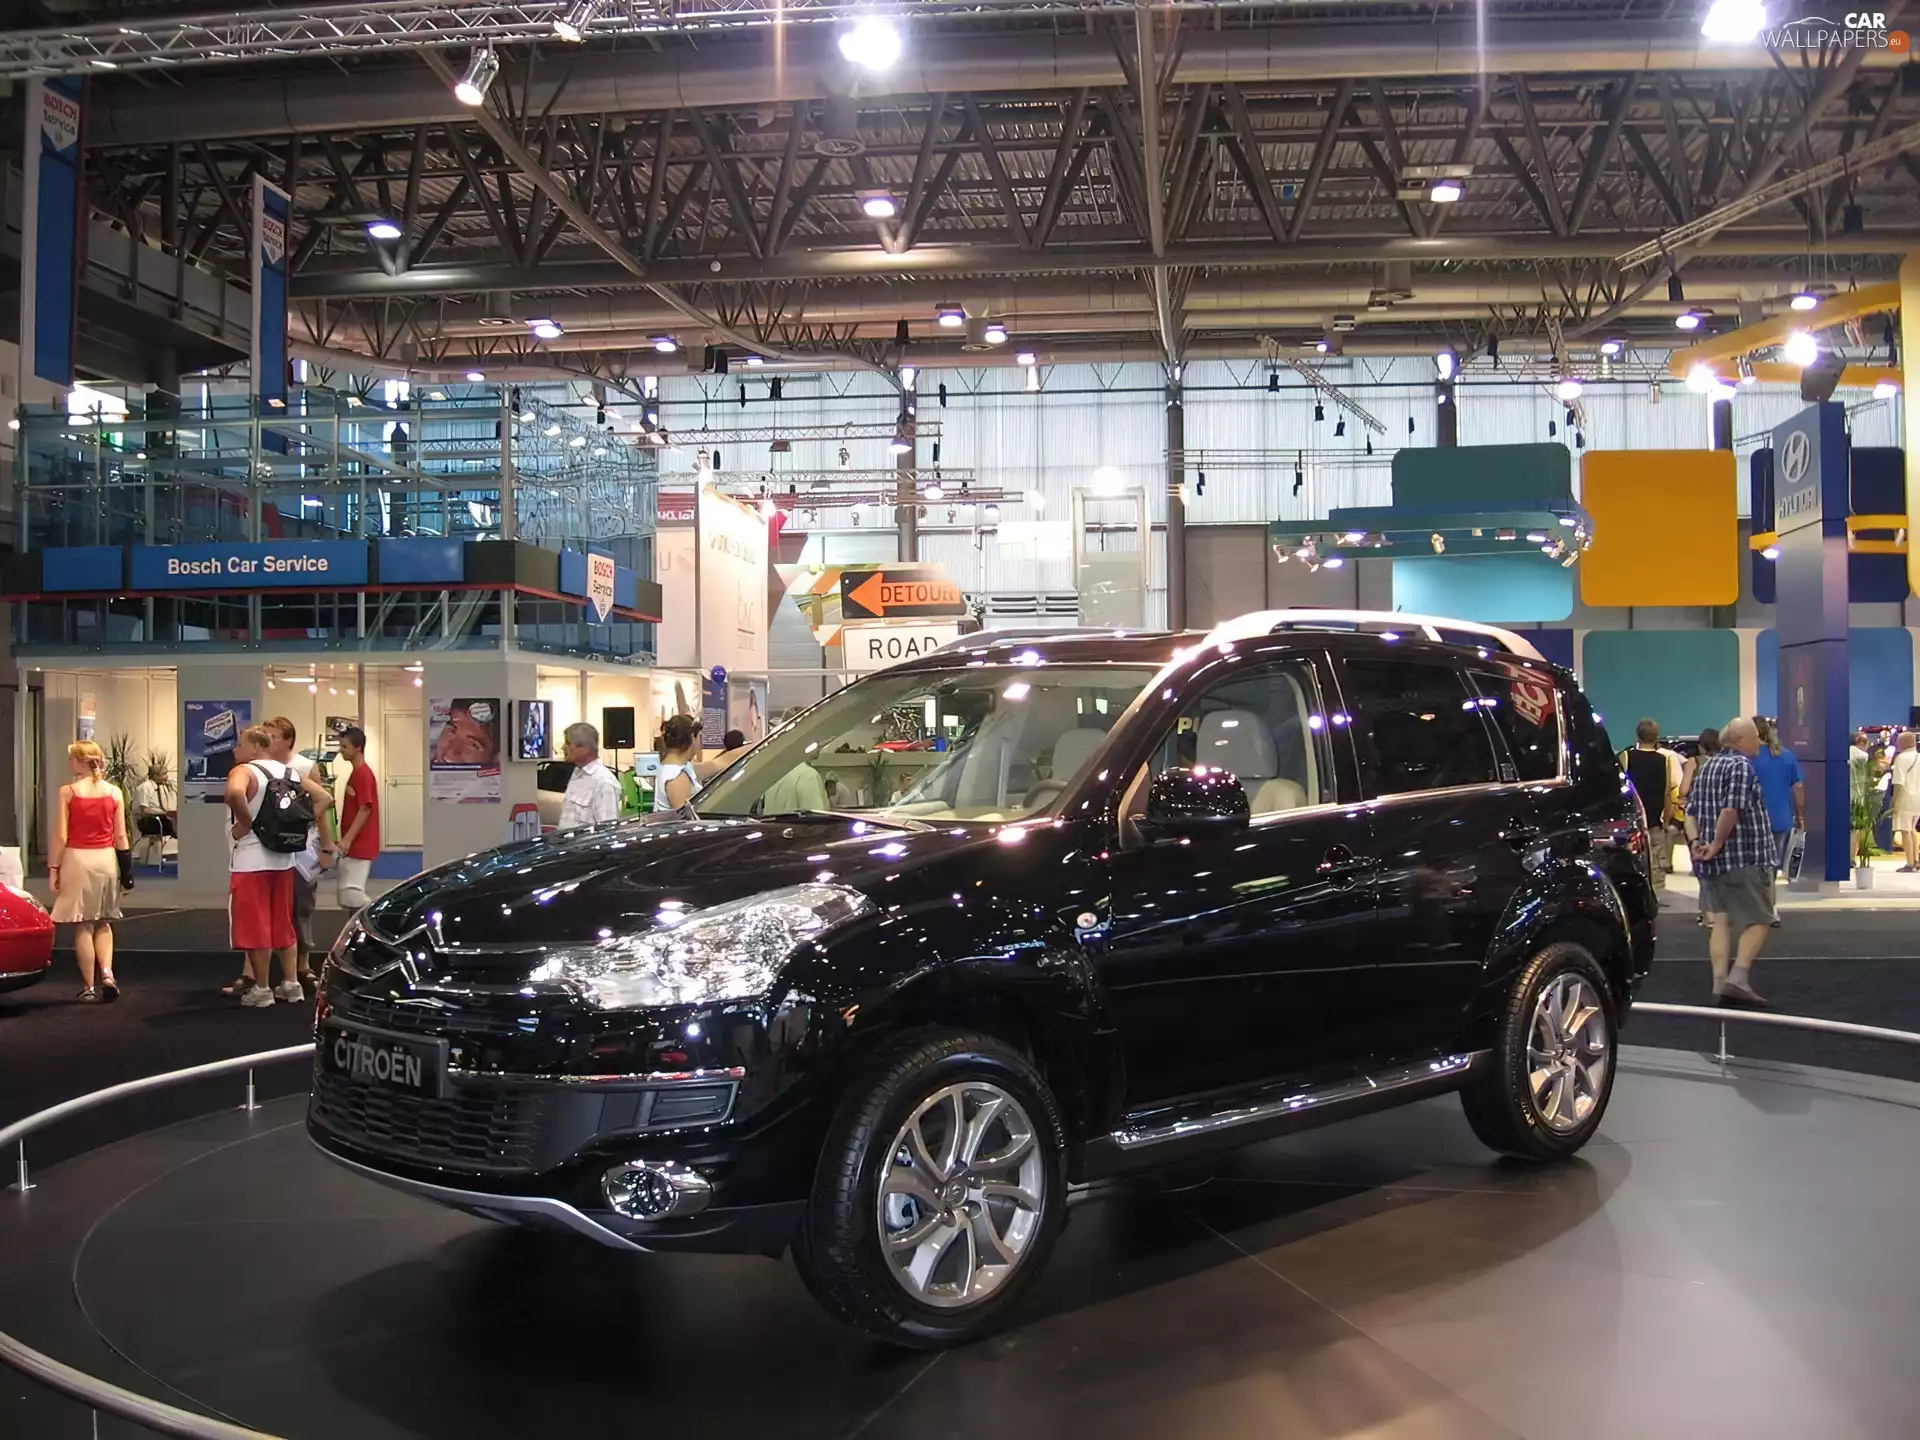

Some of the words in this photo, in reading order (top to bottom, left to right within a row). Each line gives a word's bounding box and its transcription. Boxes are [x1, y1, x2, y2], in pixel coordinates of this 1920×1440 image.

[167, 558, 222, 575] Bosch
[227, 556, 259, 574] Car
[263, 554, 329, 573] Service
[880, 584, 955, 603] DETOUR
[868, 636, 938, 660] ROAD
[334, 1038, 421, 1087] CITROËN
